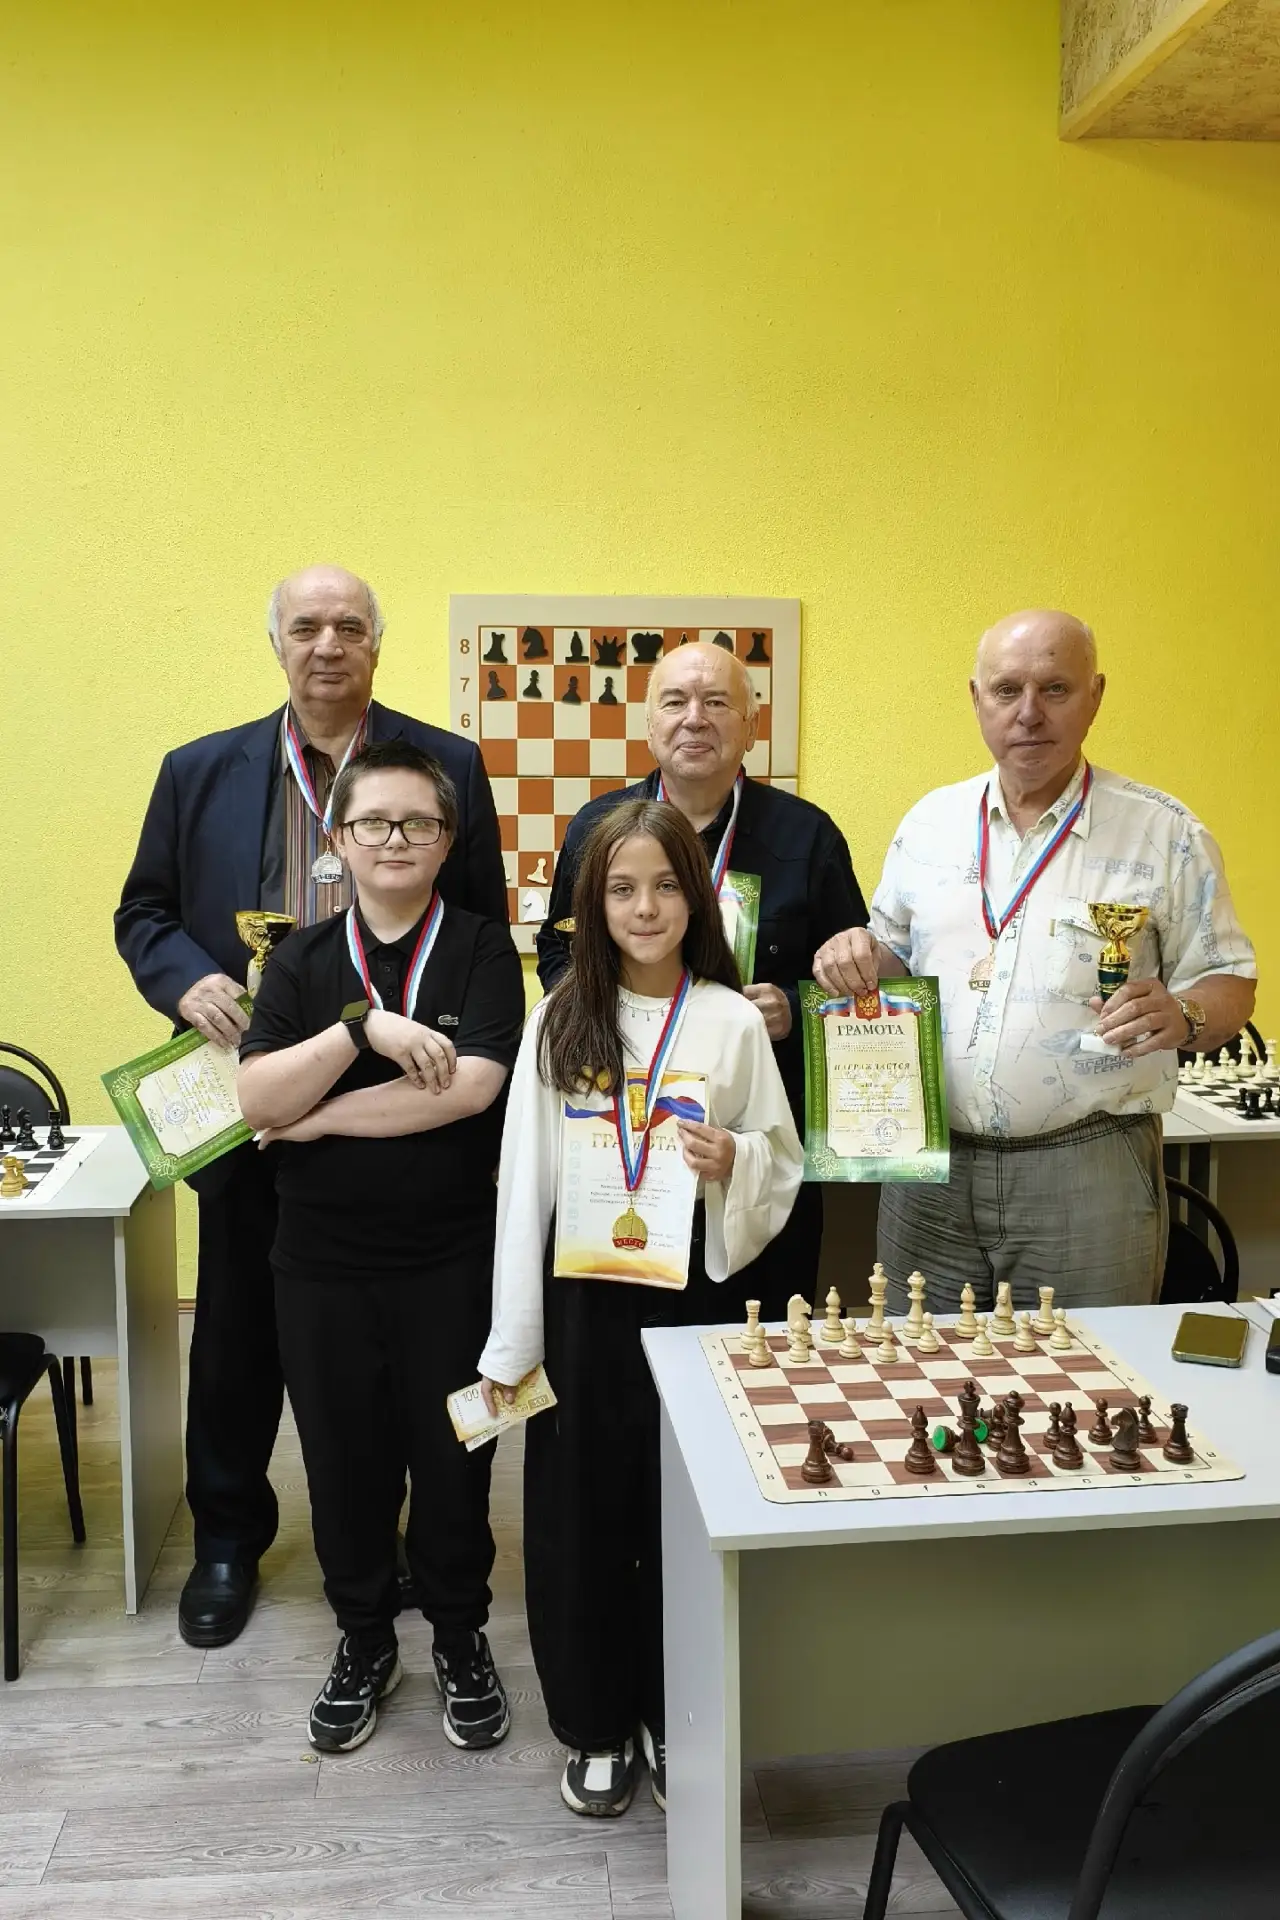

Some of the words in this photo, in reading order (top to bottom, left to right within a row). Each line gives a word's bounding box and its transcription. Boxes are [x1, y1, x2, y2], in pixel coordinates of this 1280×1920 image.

[460, 638, 470, 654] 8
[460, 677, 470, 692] 7
[460, 713, 471, 728] 6
[837, 1024, 905, 1036] ГРАМОТА
[625, 1217, 633, 1236] 1
[615, 1238, 645, 1248] МЕСТО
[461, 1387, 479, 1404] 100
